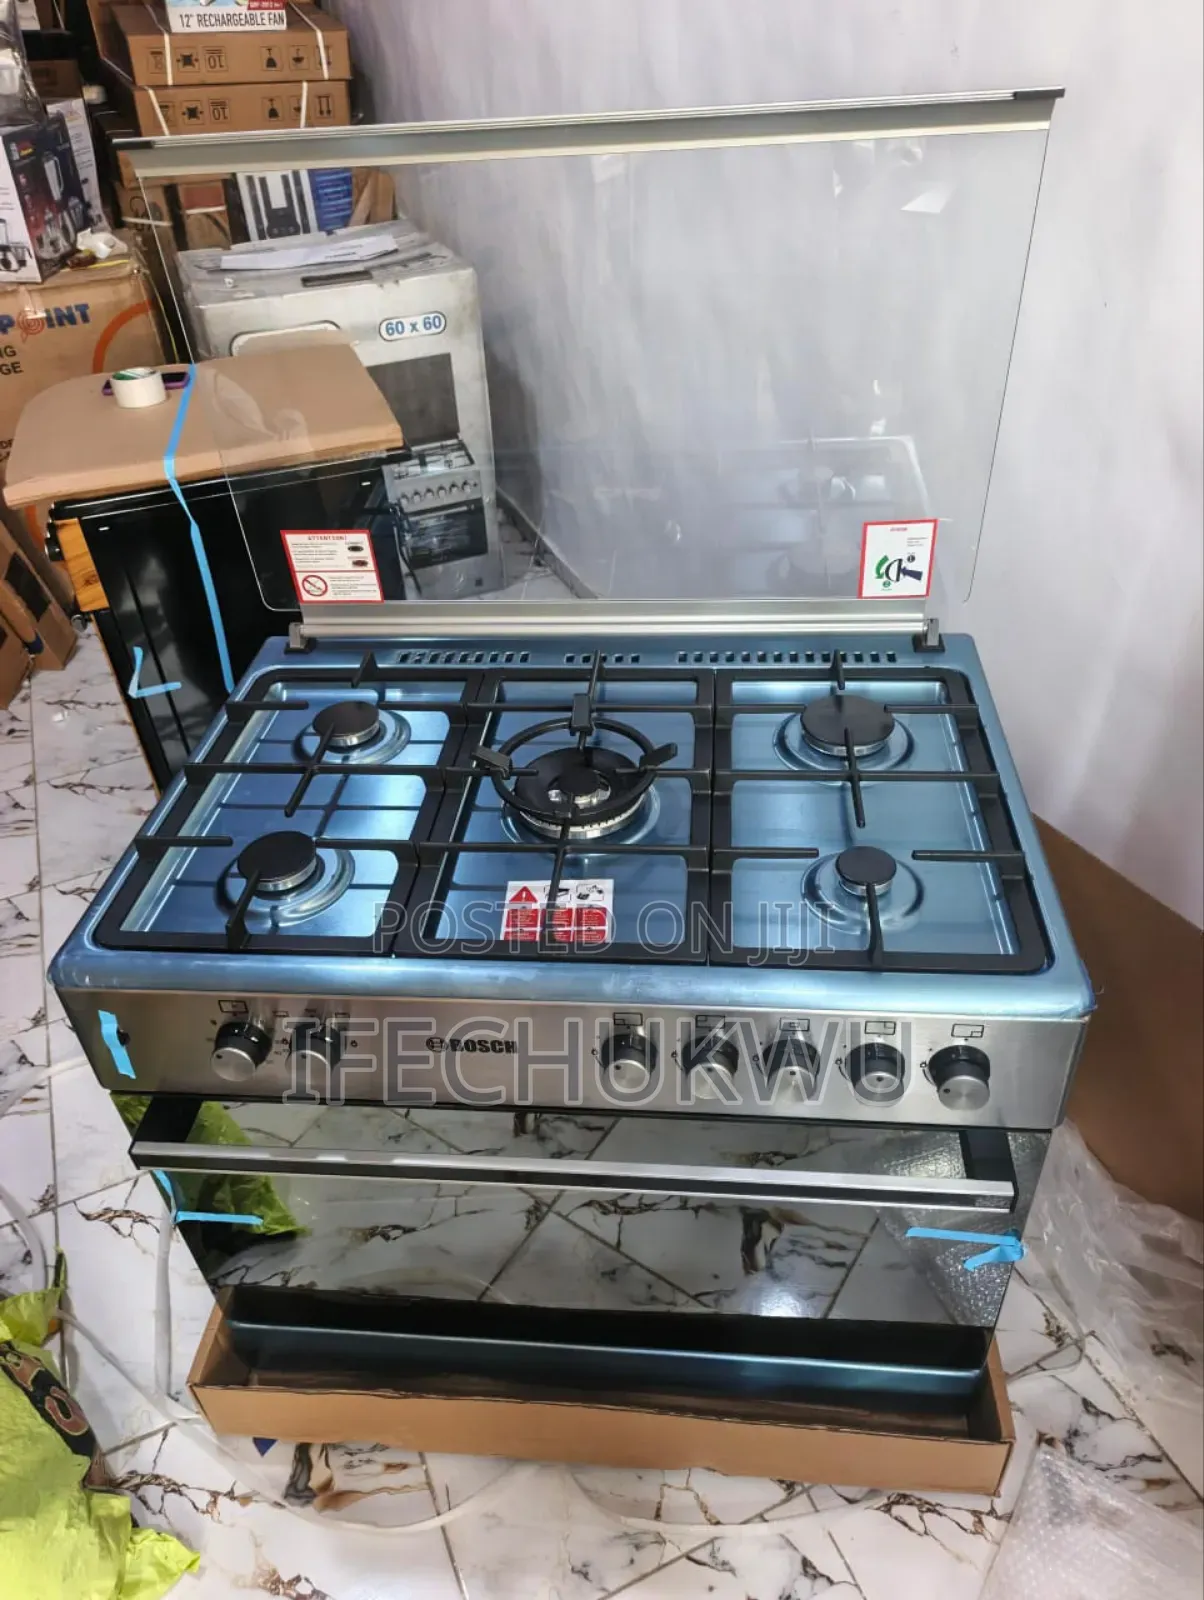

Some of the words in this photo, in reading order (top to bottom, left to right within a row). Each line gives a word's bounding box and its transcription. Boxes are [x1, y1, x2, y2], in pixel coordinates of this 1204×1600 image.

[197, 12, 266, 27] RECHARGEABLE
[268, 11, 285, 25] FAN
[385, 320, 405, 336] 60
[409, 321, 419, 333] x
[423, 315, 442, 331] 60
[449, 1037, 518, 1054] BOSCH
